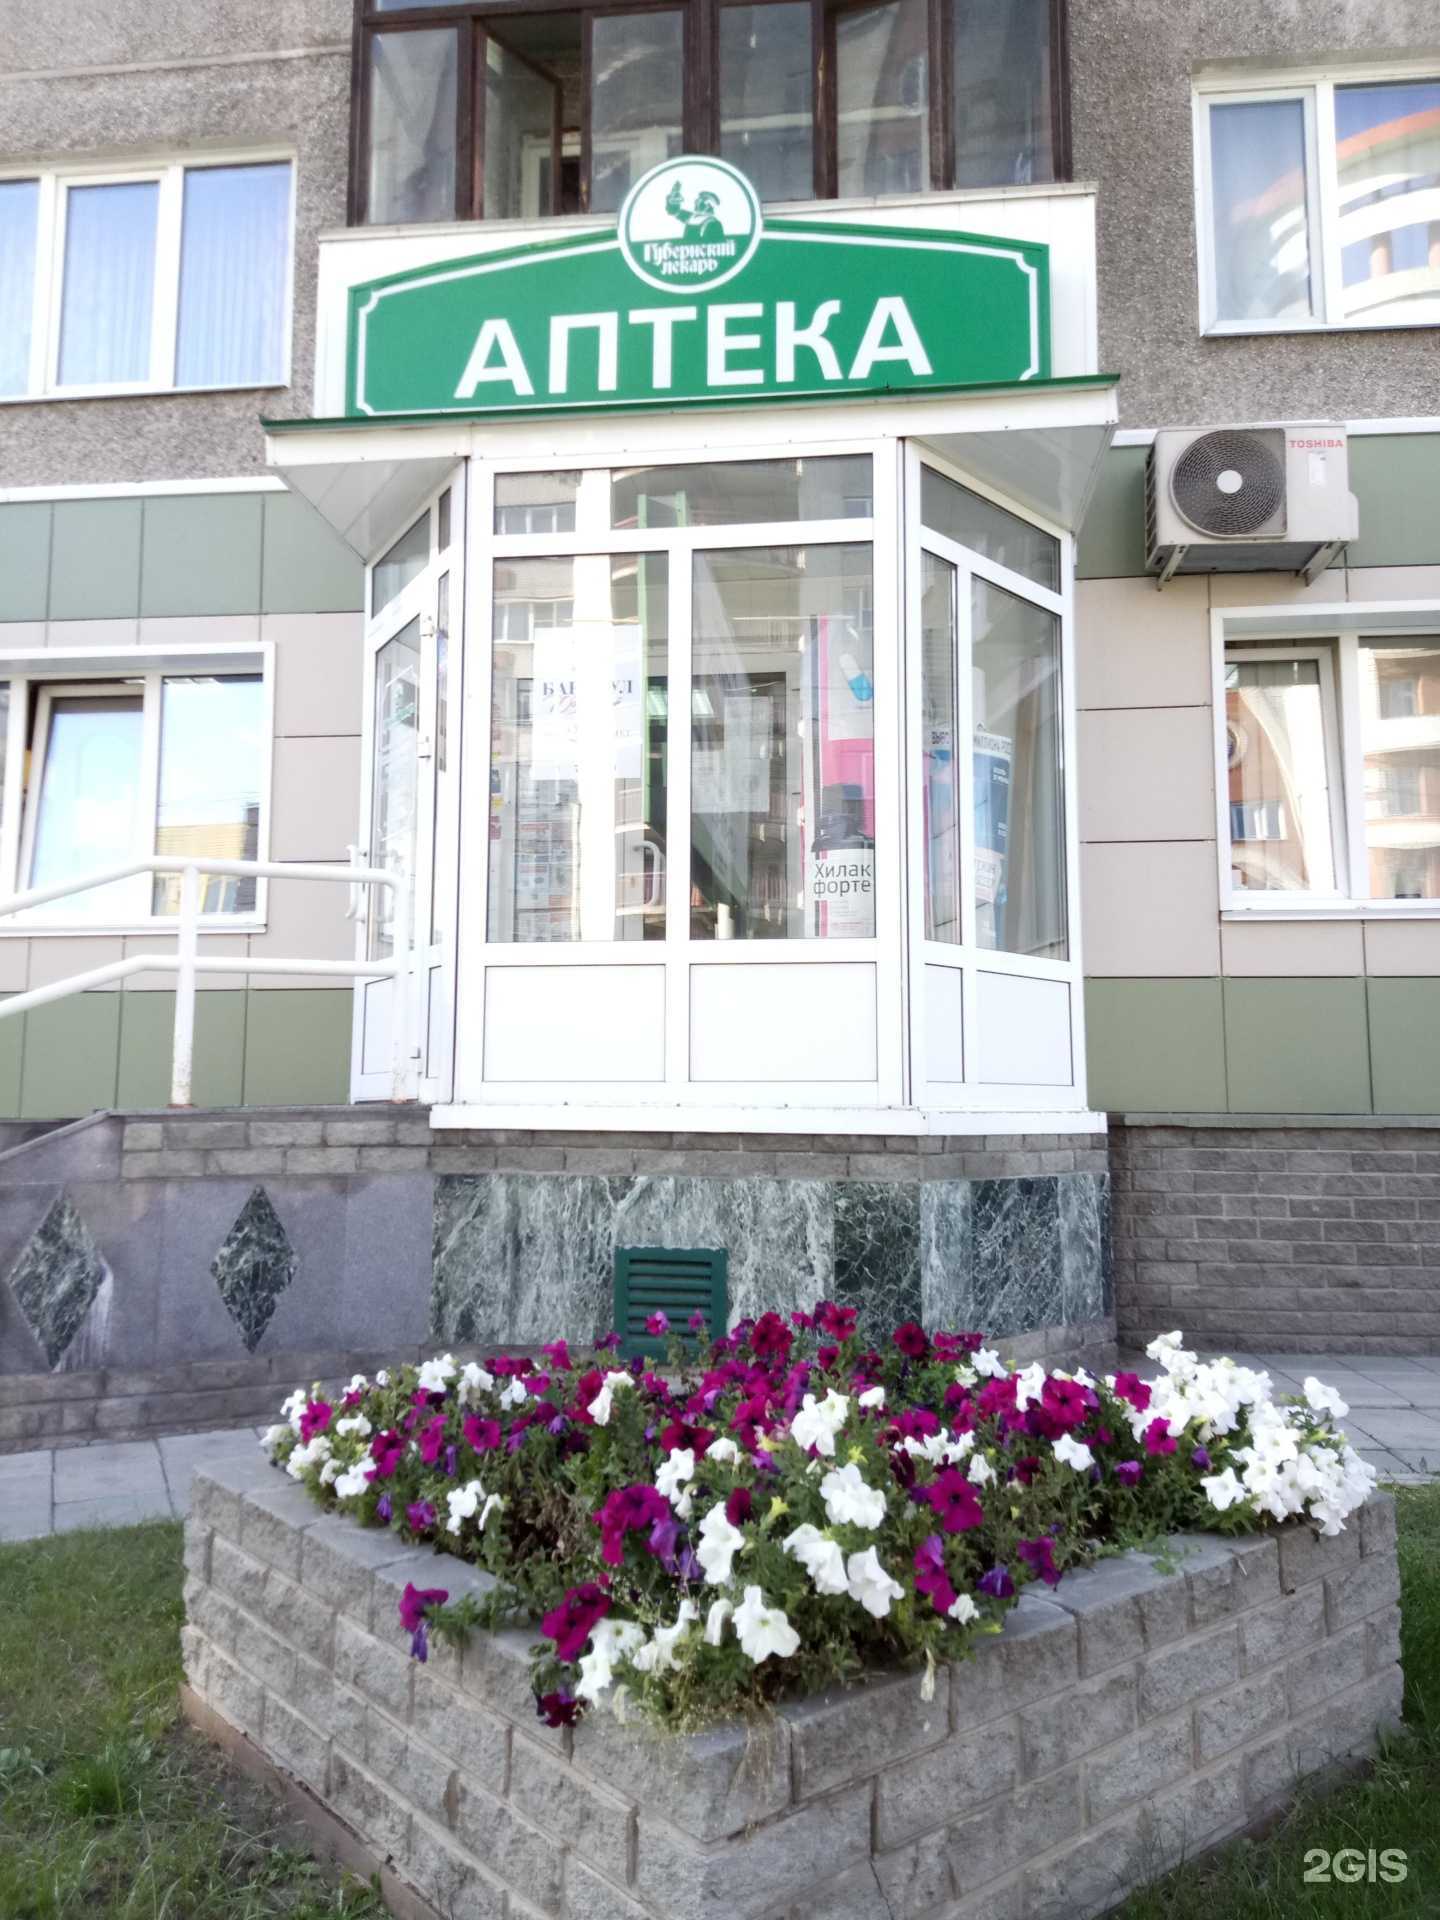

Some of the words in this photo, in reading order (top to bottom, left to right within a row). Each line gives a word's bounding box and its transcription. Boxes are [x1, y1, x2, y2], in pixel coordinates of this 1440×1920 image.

[643, 240, 736, 266] Губернский
[453, 296, 934, 399] АПТЕКА
[1288, 439, 1344, 448] TOSHIBA
[543, 680, 632, 696] БАУЛ
[815, 863, 872, 879] Хилак
[814, 879, 871, 898] форте
